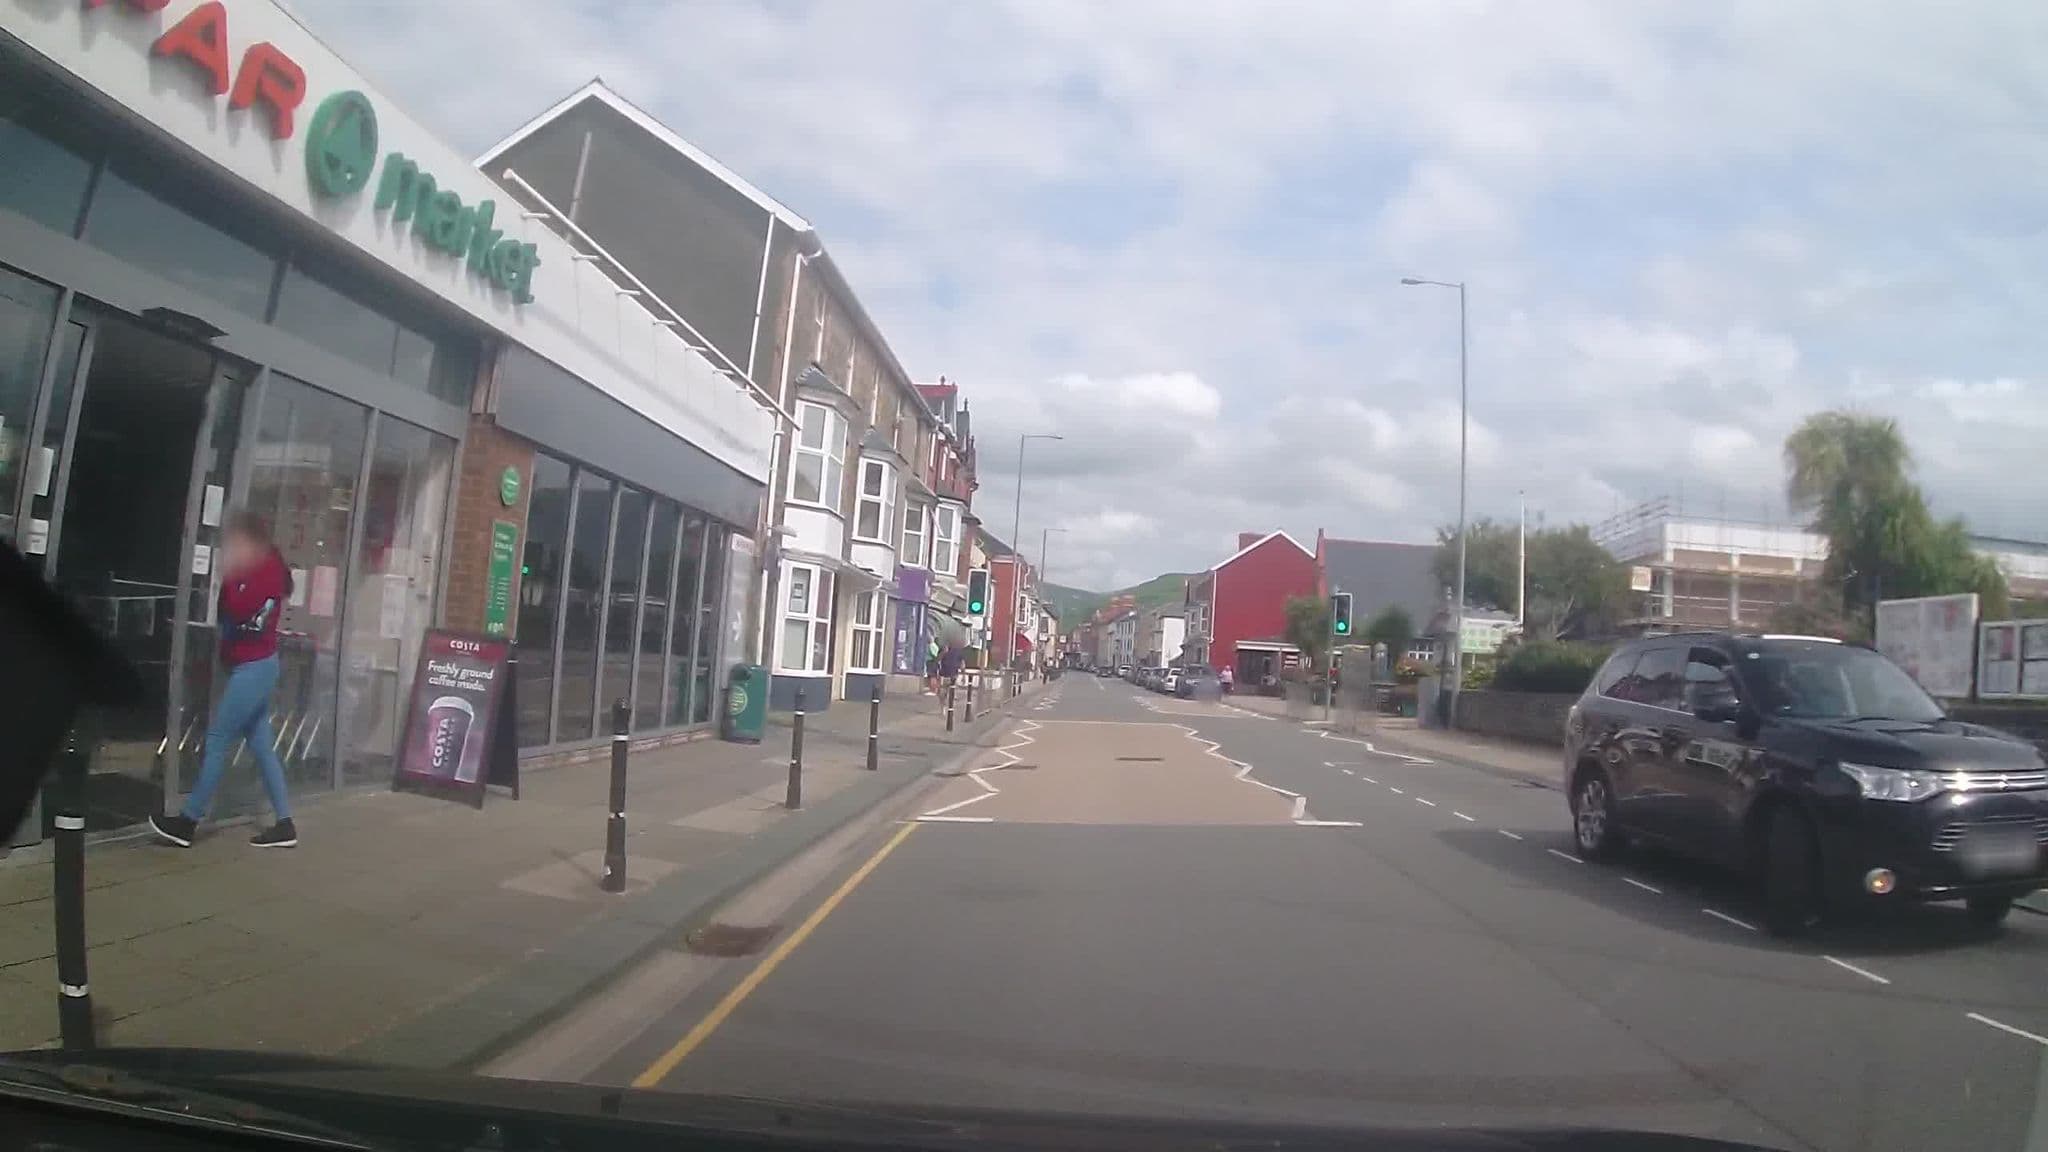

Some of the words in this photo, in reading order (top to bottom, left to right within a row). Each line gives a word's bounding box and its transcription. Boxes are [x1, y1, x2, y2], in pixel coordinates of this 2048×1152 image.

[374, 152, 541, 305] market
[449, 640, 480, 652] COSTA
[428, 660, 459, 676] Freshly
[459, 668, 494, 680] ground
[428, 675, 456, 688] coffee
